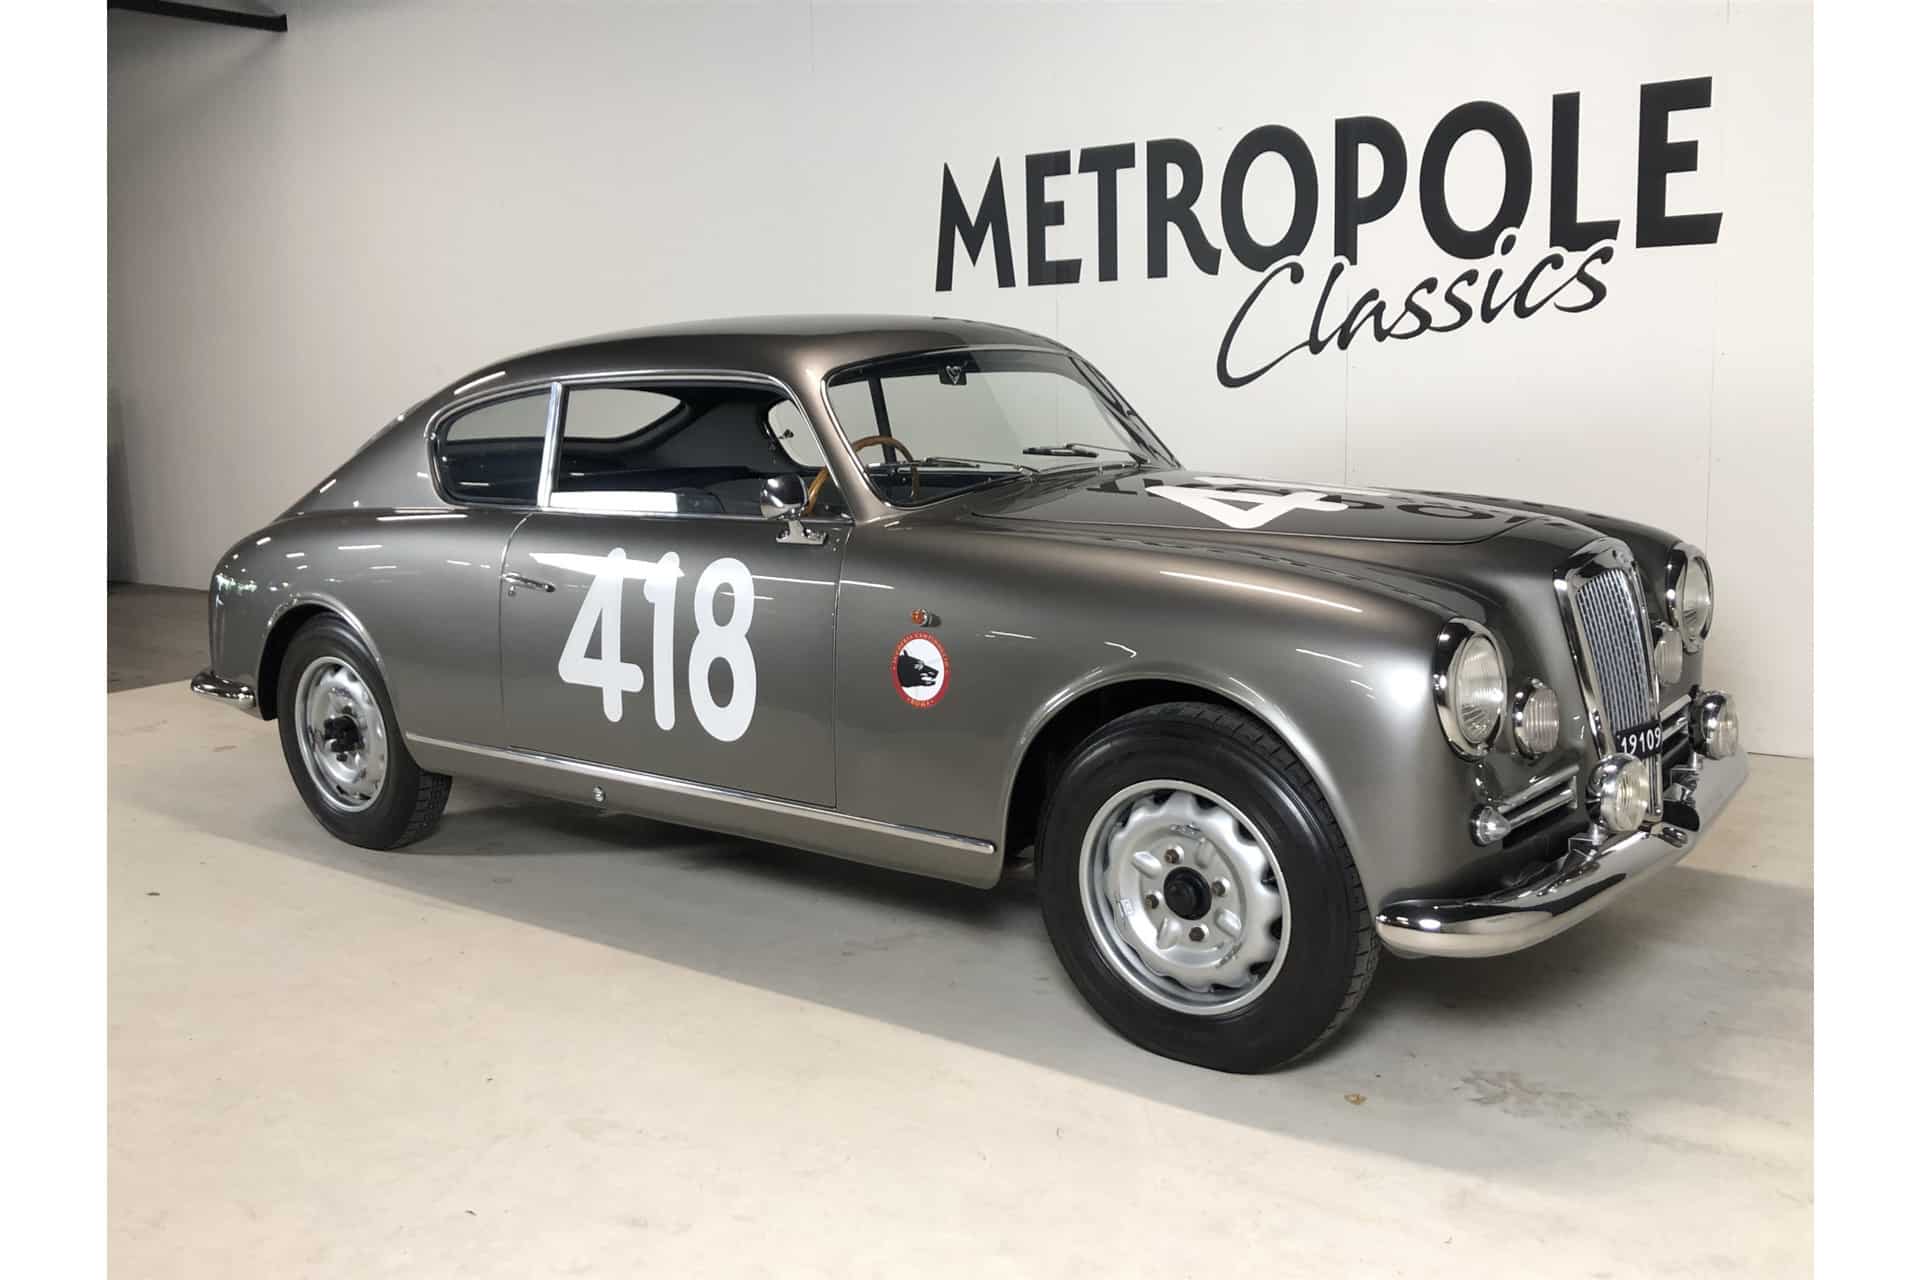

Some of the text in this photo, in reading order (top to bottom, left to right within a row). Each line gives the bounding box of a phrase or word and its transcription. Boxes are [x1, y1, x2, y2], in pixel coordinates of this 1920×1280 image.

[935, 76, 1723, 292] METROPOLE
[1216, 234, 1613, 388] Classics
[558, 548, 757, 742] 418
[1621, 727, 1661, 754] 19109
